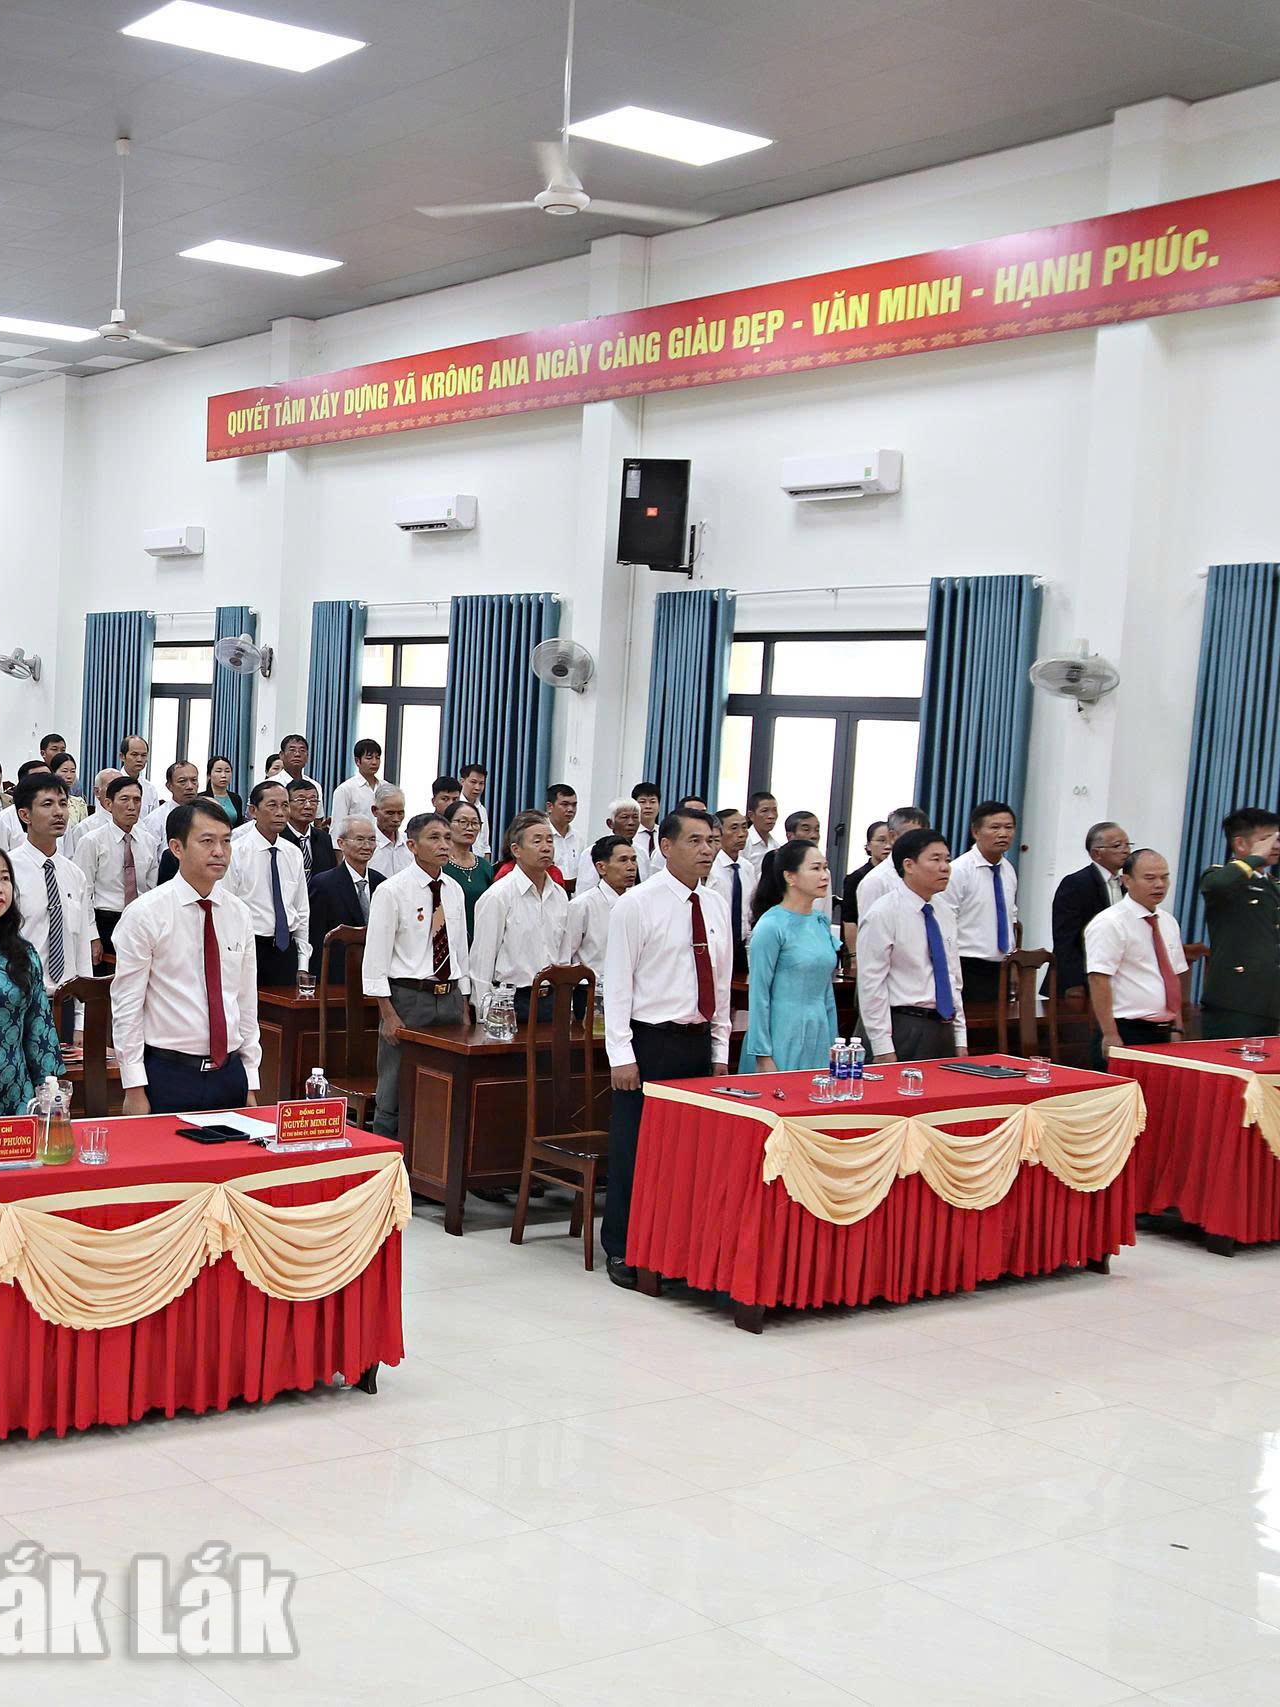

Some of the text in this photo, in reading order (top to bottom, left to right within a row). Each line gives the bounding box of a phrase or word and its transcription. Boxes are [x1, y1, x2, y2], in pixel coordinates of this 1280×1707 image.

[227, 398, 270, 437] QUYẾT
[274, 396, 305, 427] TÂM
[309, 389, 340, 423] XÂY
[344, 383, 389, 419] DỰNG
[393, 373, 417, 407] XÃ
[421, 364, 484, 402] KRÔNG
[488, 355, 530, 391] ANA
[535, 340, 593, 382] NGÀY
[599, 331, 661, 372] CÀNG
[668, 316, 726, 360] GIÀU
[732, 309, 785, 353] ĐẸP
[812, 290, 870, 336] VĂN
[877, 275, 963, 325] MINH
[994, 250, 1093, 308] HẠNH
[1102, 225, 1219, 287] PHÚC.
[310, 1118, 327, 1127] MINH
